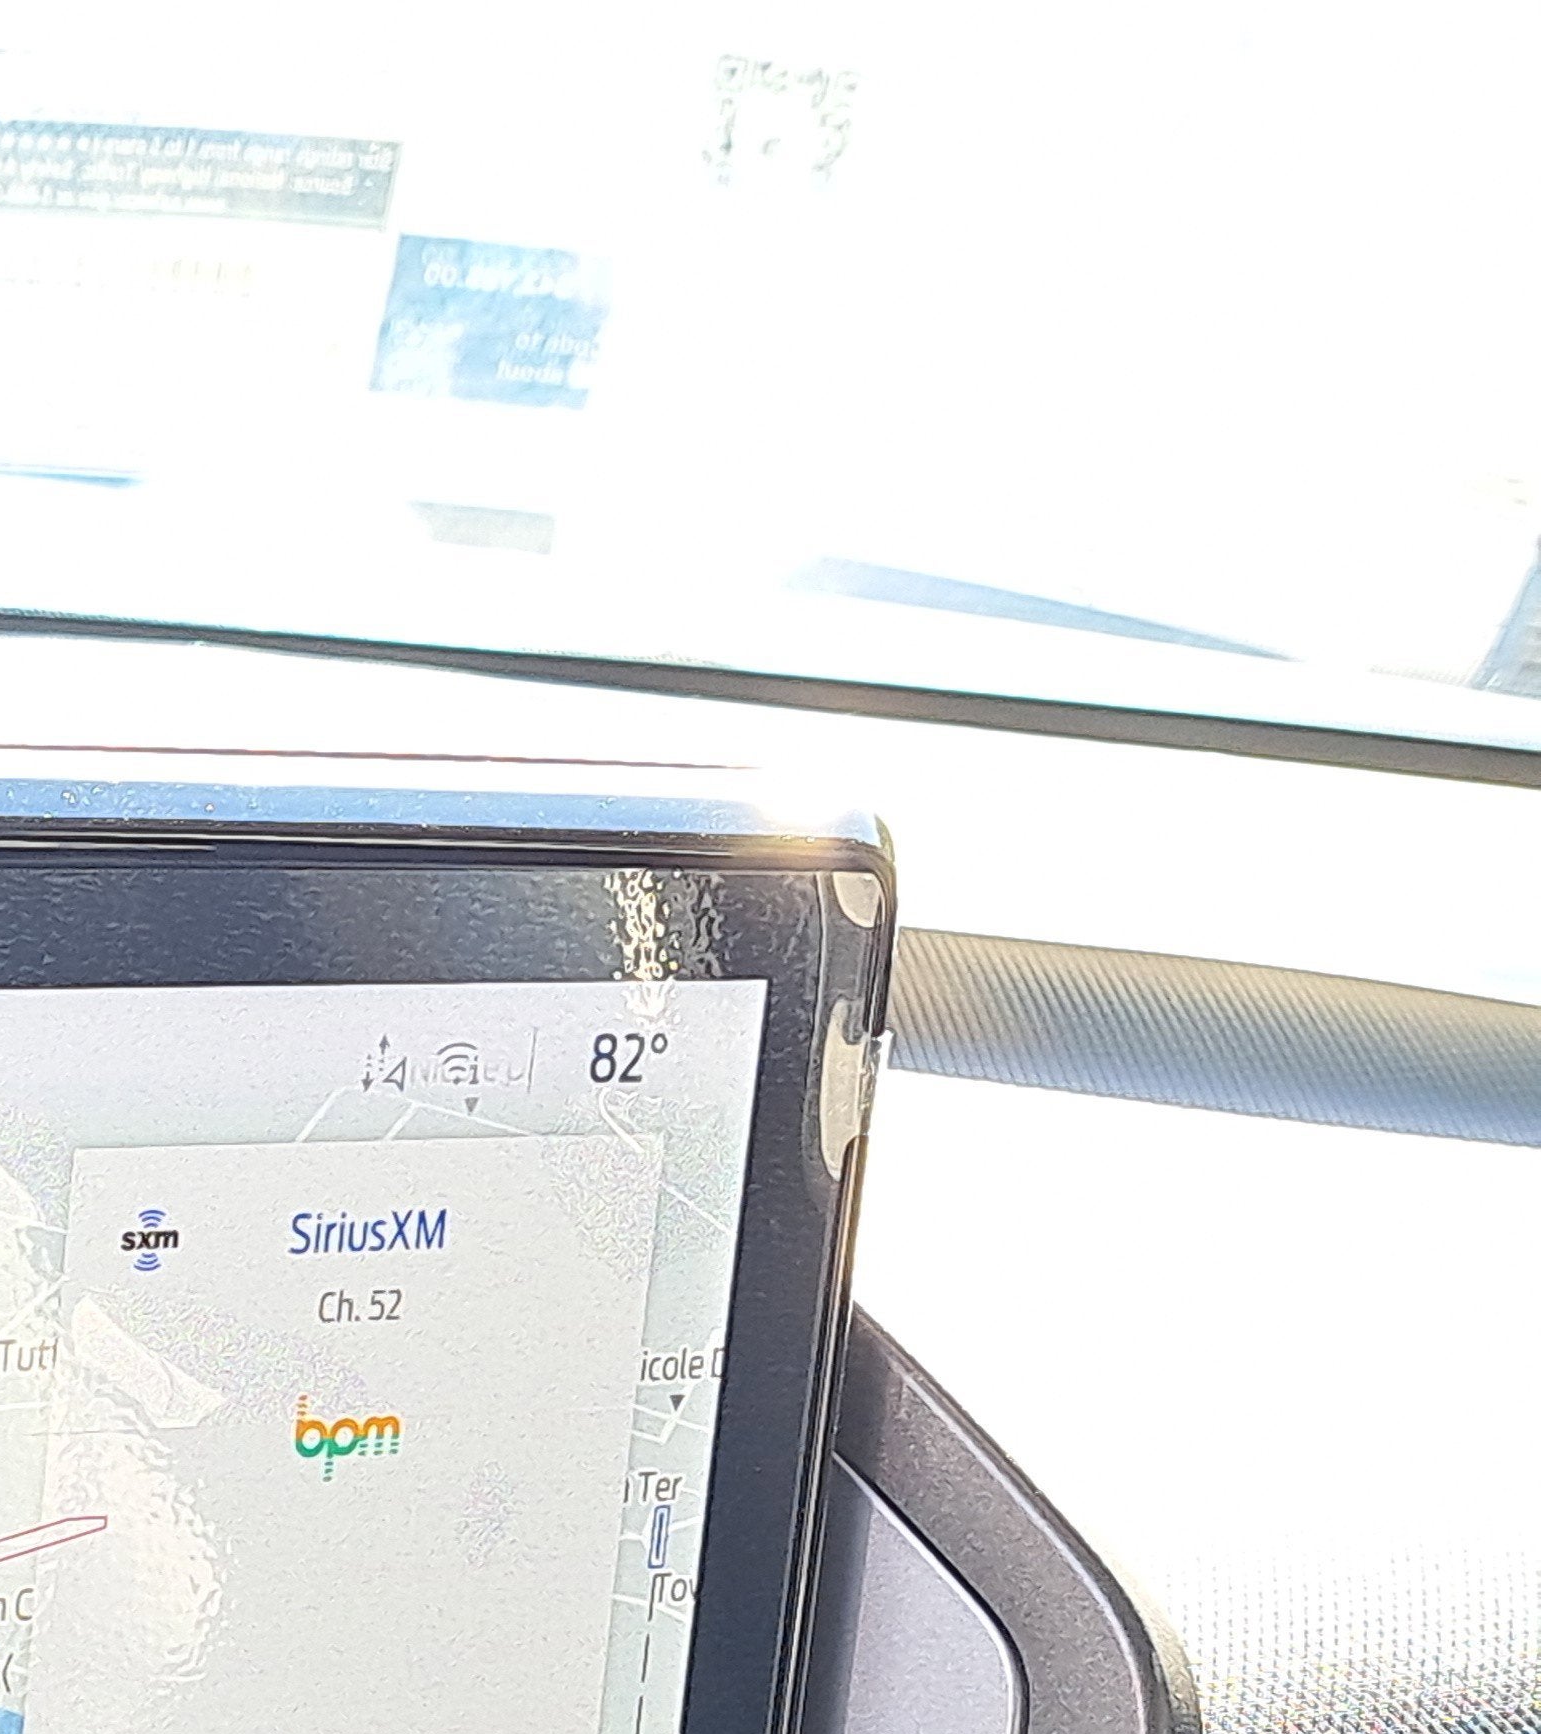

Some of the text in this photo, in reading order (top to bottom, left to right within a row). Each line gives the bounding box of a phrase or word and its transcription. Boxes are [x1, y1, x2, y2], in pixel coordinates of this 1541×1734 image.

[590, 1033, 669, 1084] 82°
[120, 1227, 179, 1251] sxm
[287, 1209, 447, 1257] SiriusXM
[317, 1288, 403, 1323] Ch. 52
[294, 1394, 401, 1483] bpm
[638, 1470, 683, 1501] Ter
